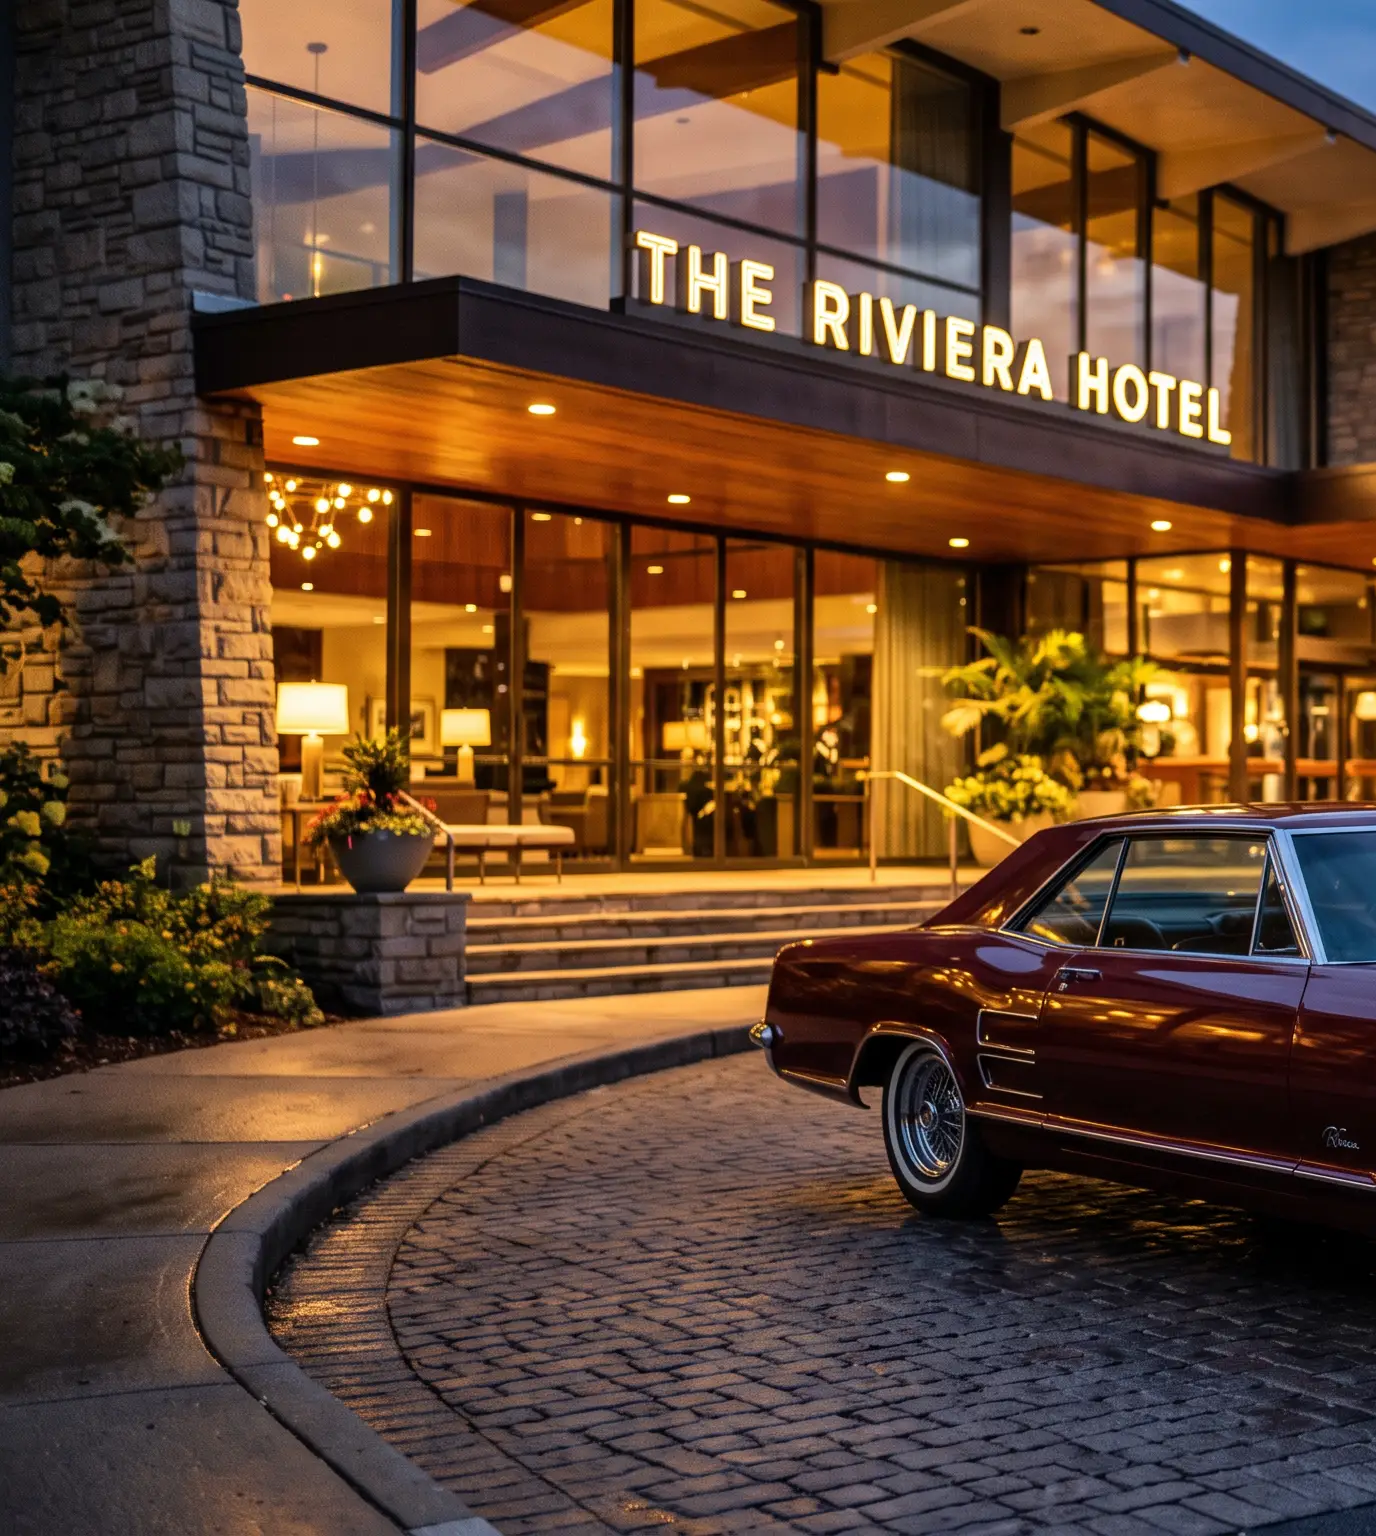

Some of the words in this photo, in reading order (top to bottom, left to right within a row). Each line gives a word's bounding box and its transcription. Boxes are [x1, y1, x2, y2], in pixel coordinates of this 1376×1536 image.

[636, 230, 776, 332] THE
[811, 279, 1054, 401] RIVIERA
[1076, 351, 1233, 446] HOTEL
